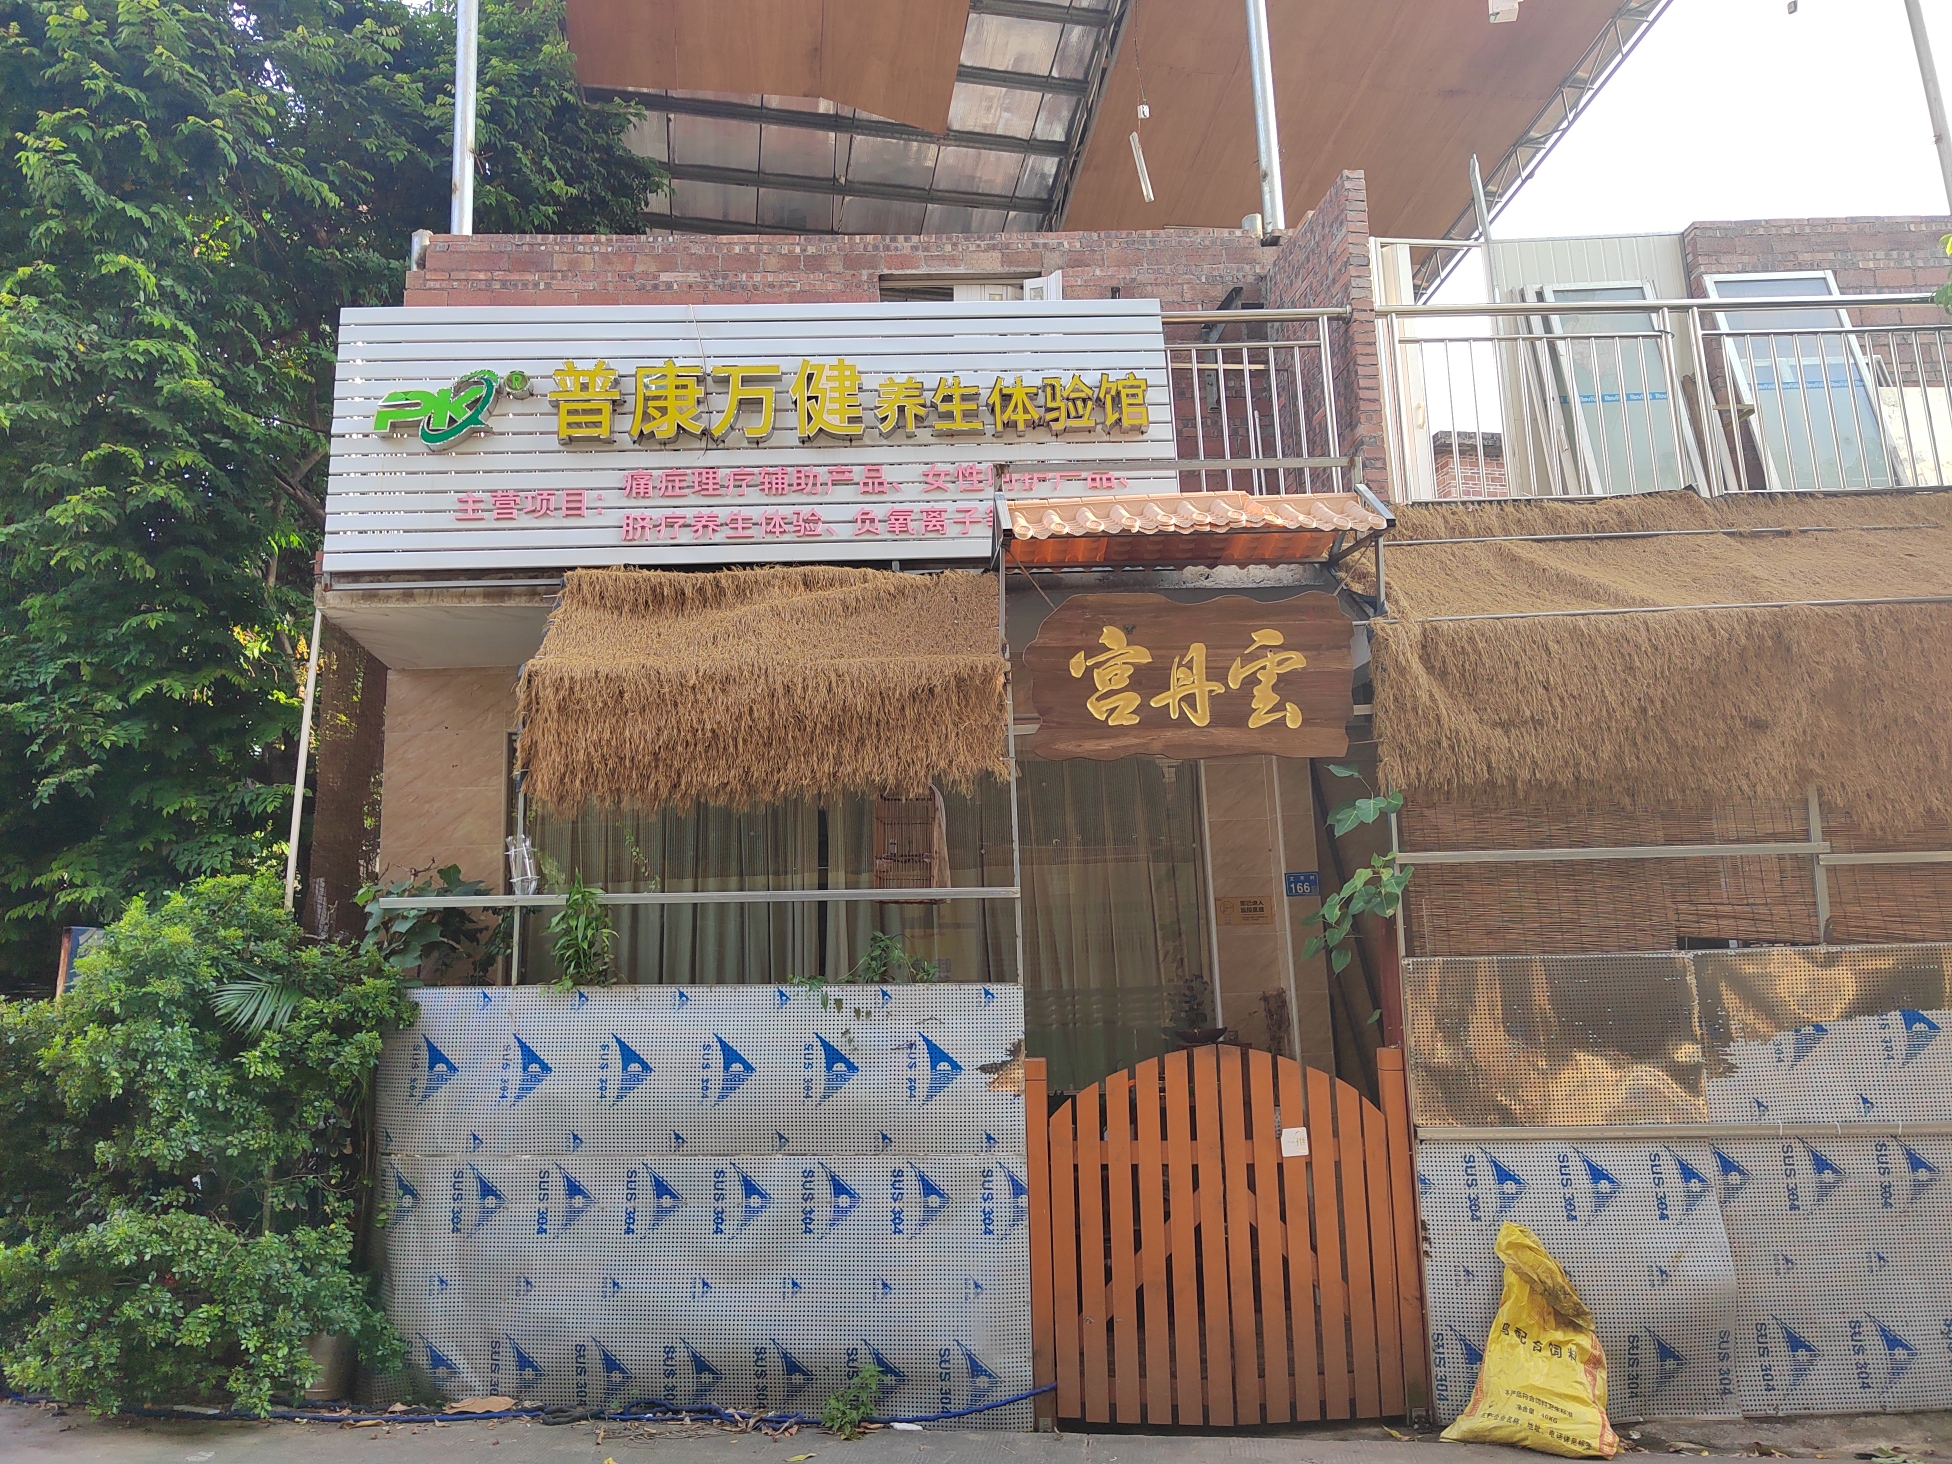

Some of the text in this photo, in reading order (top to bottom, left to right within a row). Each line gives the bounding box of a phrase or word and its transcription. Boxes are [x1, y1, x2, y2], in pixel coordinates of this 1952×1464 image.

[620, 506, 993, 543] 脐疗养生体验、负氧离子
[1290, 882, 1311, 894] 166
[1879, 1012, 1889, 1031] US
[1463, 1154, 1478, 1188] SUS
[1558, 1154, 1572, 1188] SUS
[1649, 1152, 1663, 1187] SUS
[1782, 1144, 1796, 1178] SUS
[1876, 1142, 1889, 1176] SUS
[453, 1170, 463, 1201] SUS
[540, 1169, 550, 1203] SUS
[626, 1169, 637, 1203] SUS
[714, 1169, 725, 1202] SUS
[802, 1169, 814, 1202] SUS
[892, 1168, 903, 1202] SUS
[982, 1168, 993, 1202] SUS
[1628, 1334, 1639, 1368] SUS
[1718, 1330, 1730, 1364] SUS
[1850, 1320, 1863, 1355] SUS
[490, 1339, 501, 1396] SUS 30
[577, 1343, 587, 1376] SUS
[664, 1344, 674, 1403] SUS 30
[755, 1344, 766, 1378] SUS
[940, 1347, 950, 1380] SUS
